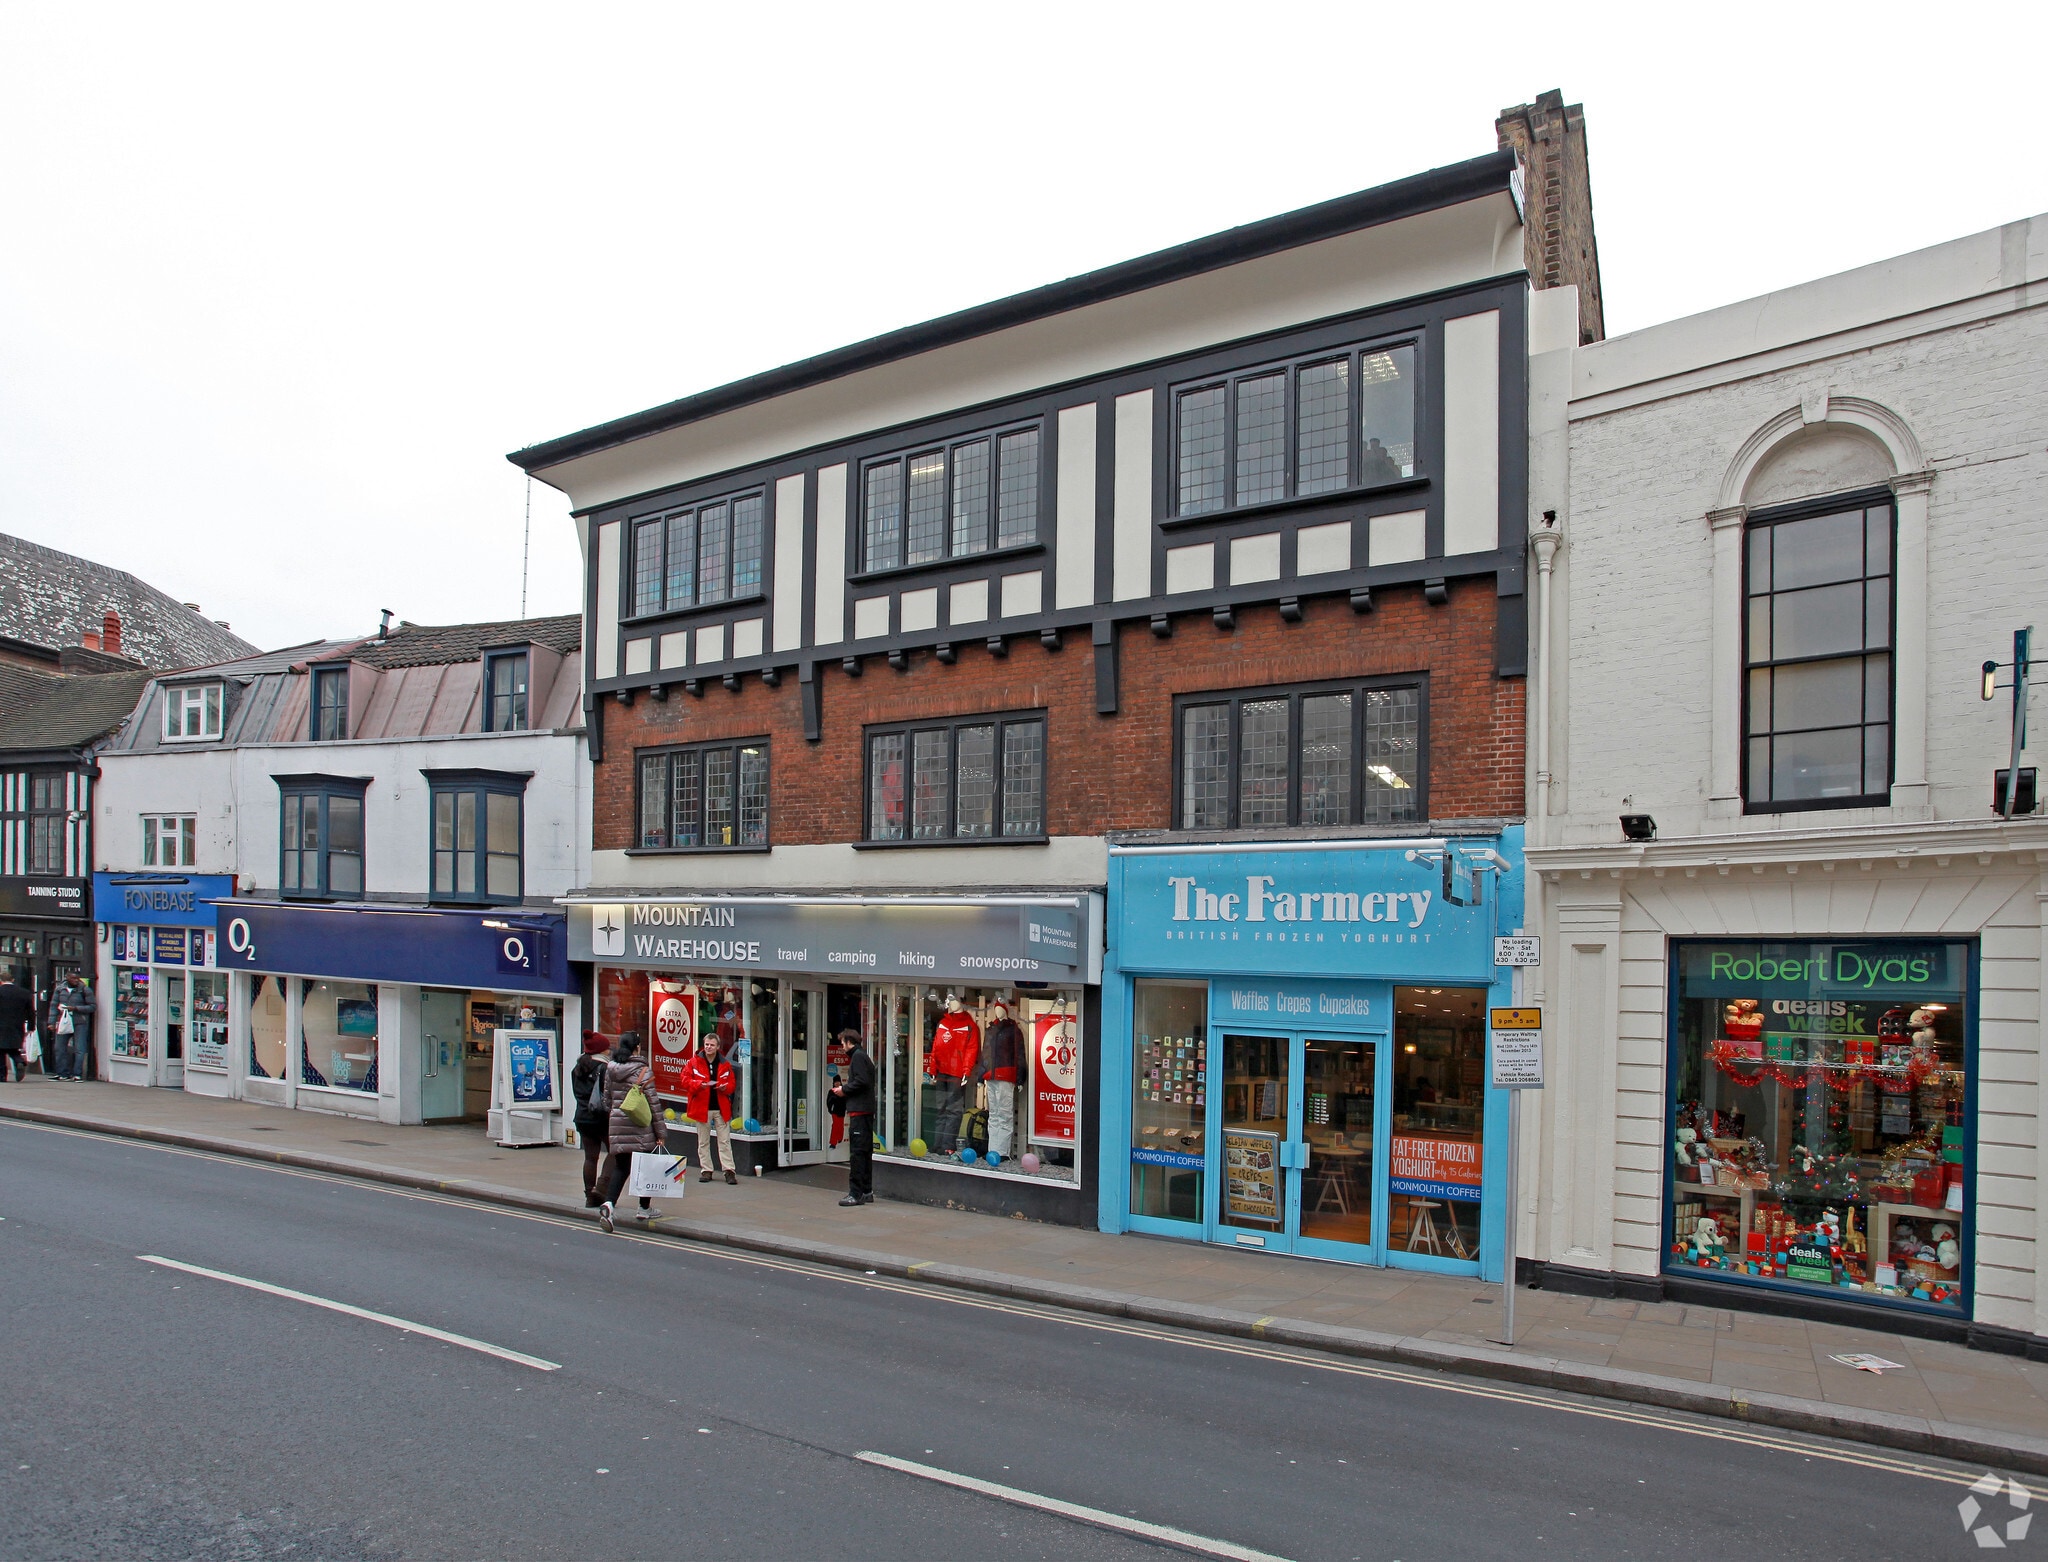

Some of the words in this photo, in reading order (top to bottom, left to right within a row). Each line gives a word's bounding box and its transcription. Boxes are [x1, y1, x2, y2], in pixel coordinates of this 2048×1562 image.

[27, 886, 57, 897] TANNING
[57, 887, 80, 898] STUDIO
[125, 890, 195, 912] FONEBASE
[1168, 876, 1240, 922] The
[1245, 875, 1432, 929] Farmery
[633, 904, 735, 927] MOUNTAIN
[1042, 925, 1071, 938] MOUNTAIN
[1166, 931, 1240, 941] BRITISH
[1255, 932, 1324, 942] FROZEN
[1341, 933, 1431, 943] YOGHURT
[633, 934, 761, 962] WAREHOUSE
[1042, 935, 1077, 949] WAREHOUSE
[777, 948, 807, 961] travel
[828, 950, 876, 967] camping
[899, 951, 936, 968] hiking
[960, 954, 1039, 971] snowsports
[1711, 952, 1828, 982] Robert
[1836, 952, 1929, 988] Dyas
[1231, 990, 1269, 1011] Waffles
[1277, 991, 1311, 1015] Crepes
[1319, 993, 1369, 1016] Cupcakes
[665, 1010, 682, 1018] EXTRA
[659, 1018, 688, 1036] 20%
[1787, 1012, 1865, 1033] week
[511, 1044, 534, 1055] Grab
[332, 1058, 351, 1069] more
[663, 1064, 682, 1073] TODAY
[1226, 1135, 1248, 1147] BELGIAN
[1250, 1139, 1272, 1149] WAFFLES
[1392, 1138, 1435, 1159] FAT-FREE
[1437, 1142, 1475, 1163] FROZEN
[1133, 1151, 1175, 1164] MONMOUTH
[1177, 1156, 1205, 1168] COFFEE
[1239, 1169, 1263, 1181] CREPES
[1392, 1157, 1437, 1178] YOGHURT
[1435, 1165, 1447, 1179] only
[1458, 1167, 1482, 1179] Calories
[1392, 1181, 1444, 1194] MONMOUTH
[1446, 1186, 1481, 1198] COFFEE
[1230, 1201, 1241, 1210] HOT
[1244, 1204, 1275, 1216] CHOCOLATE
[1789, 1246, 1822, 1259] deals
[1795, 1256, 1830, 1267] week
